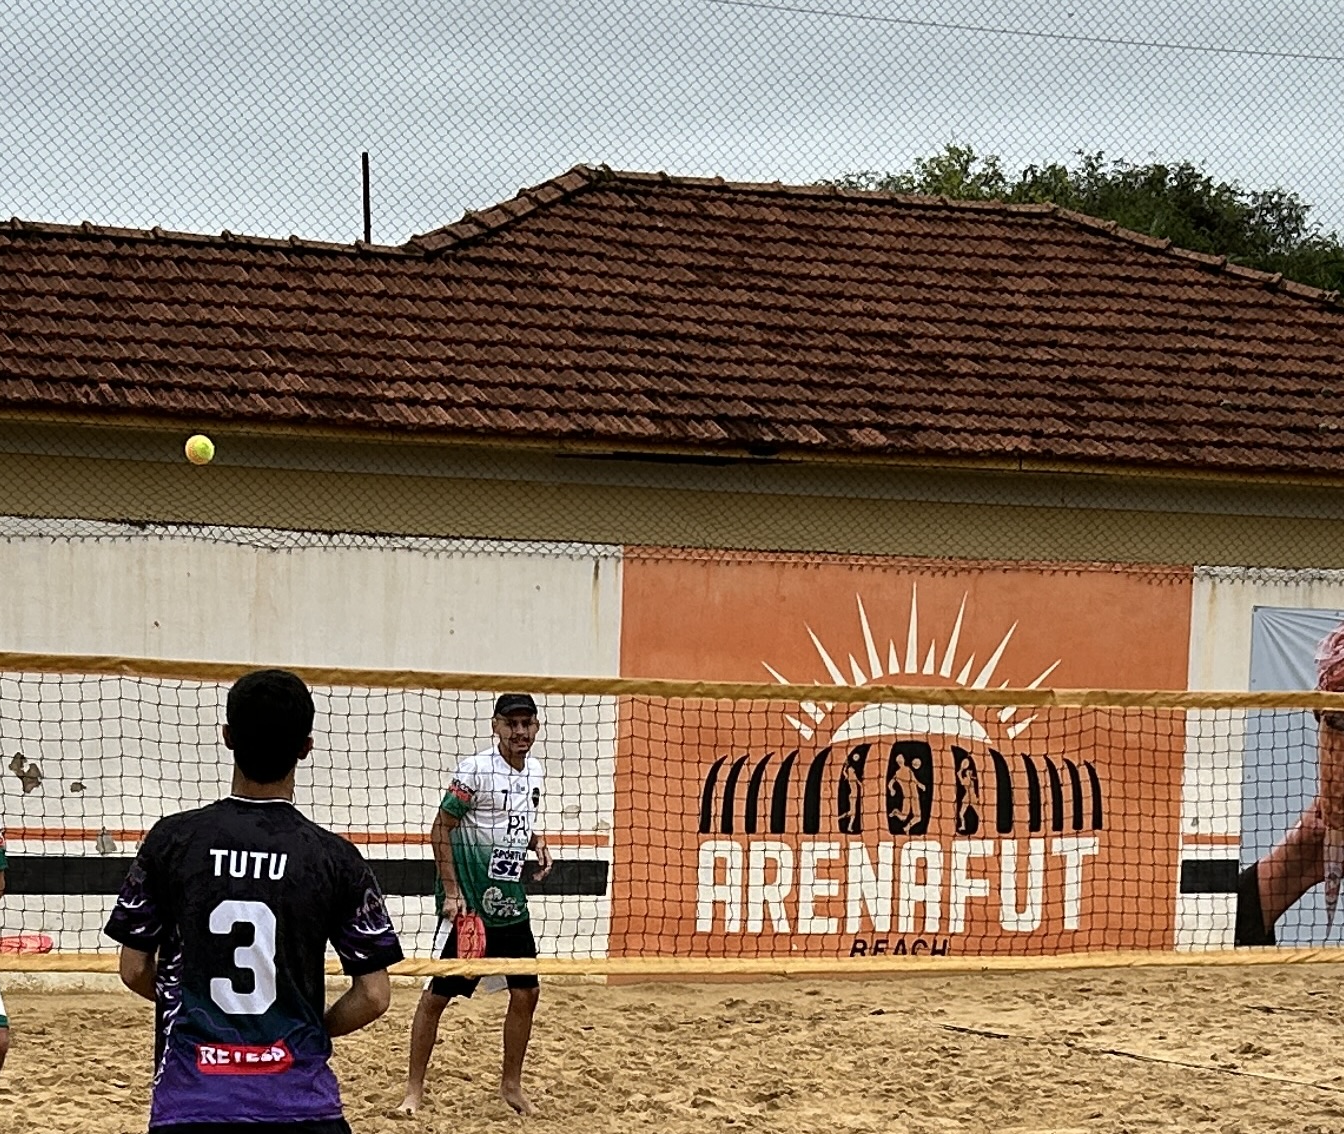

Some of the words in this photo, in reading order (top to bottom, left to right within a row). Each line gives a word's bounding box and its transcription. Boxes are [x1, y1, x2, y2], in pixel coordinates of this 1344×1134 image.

[210, 849, 287, 880] TUTU
[696, 836, 1100, 934] ARENAFUT
[209, 900, 277, 1014] 3
